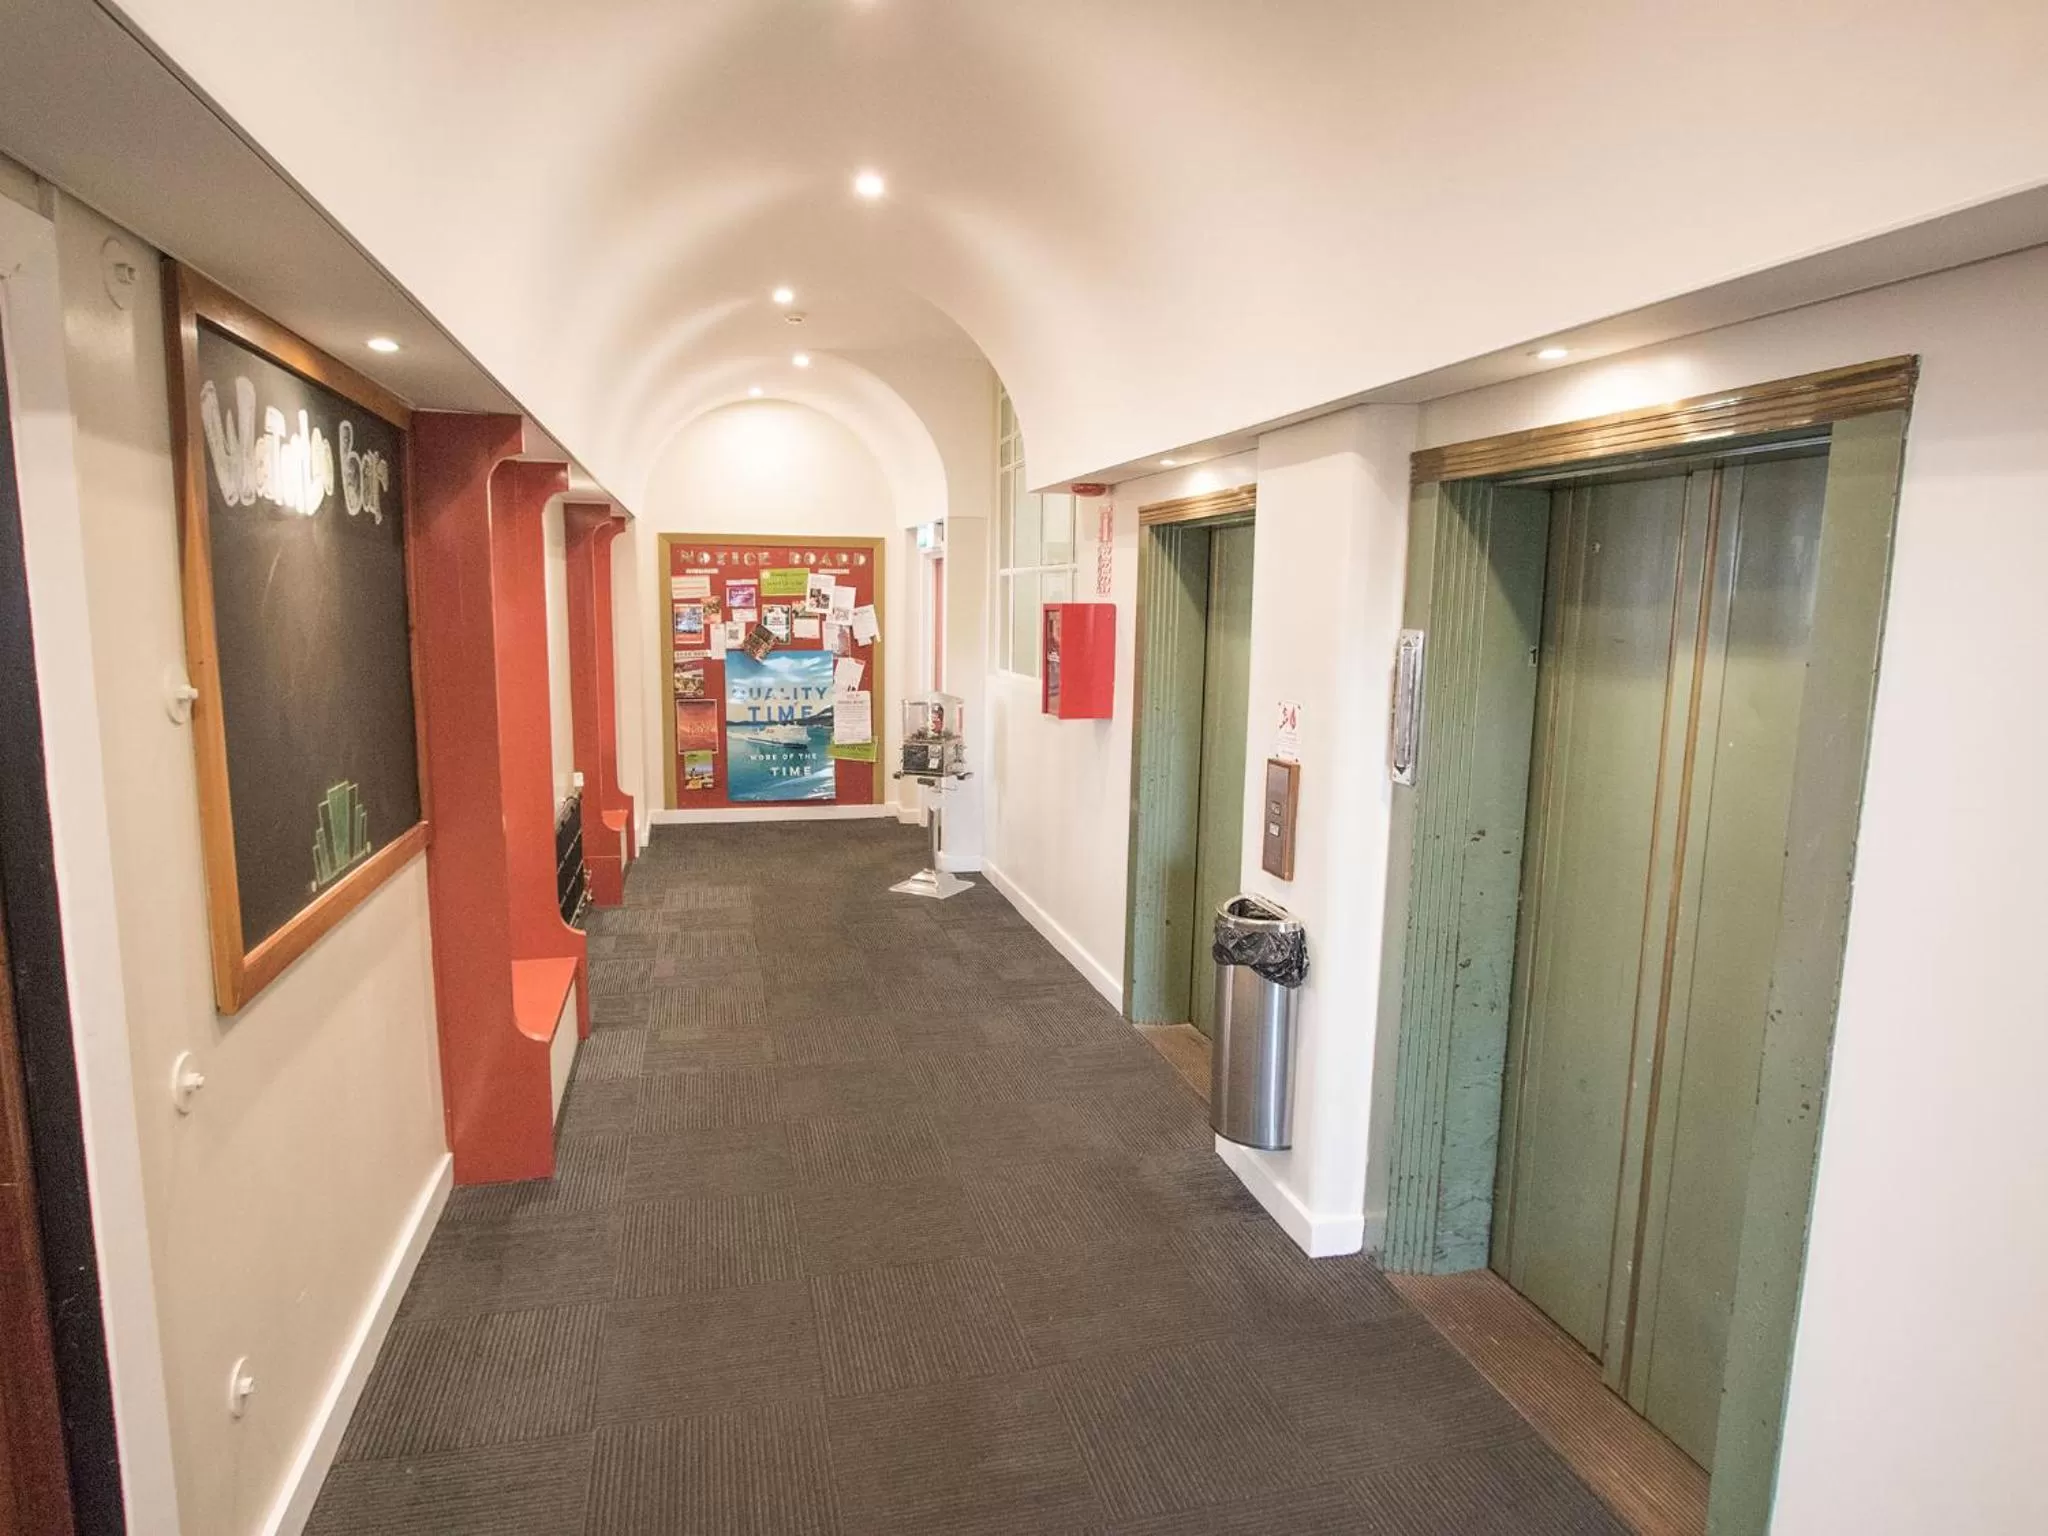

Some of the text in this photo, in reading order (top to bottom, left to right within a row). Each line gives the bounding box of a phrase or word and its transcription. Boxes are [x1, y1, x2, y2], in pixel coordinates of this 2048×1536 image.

[680, 550, 867, 567] NOTICE BOARD
[731, 686, 828, 701] QUALITY
[747, 705, 813, 722] TIME
[799, 752, 817, 760] THE
[770, 766, 812, 777] TIME
